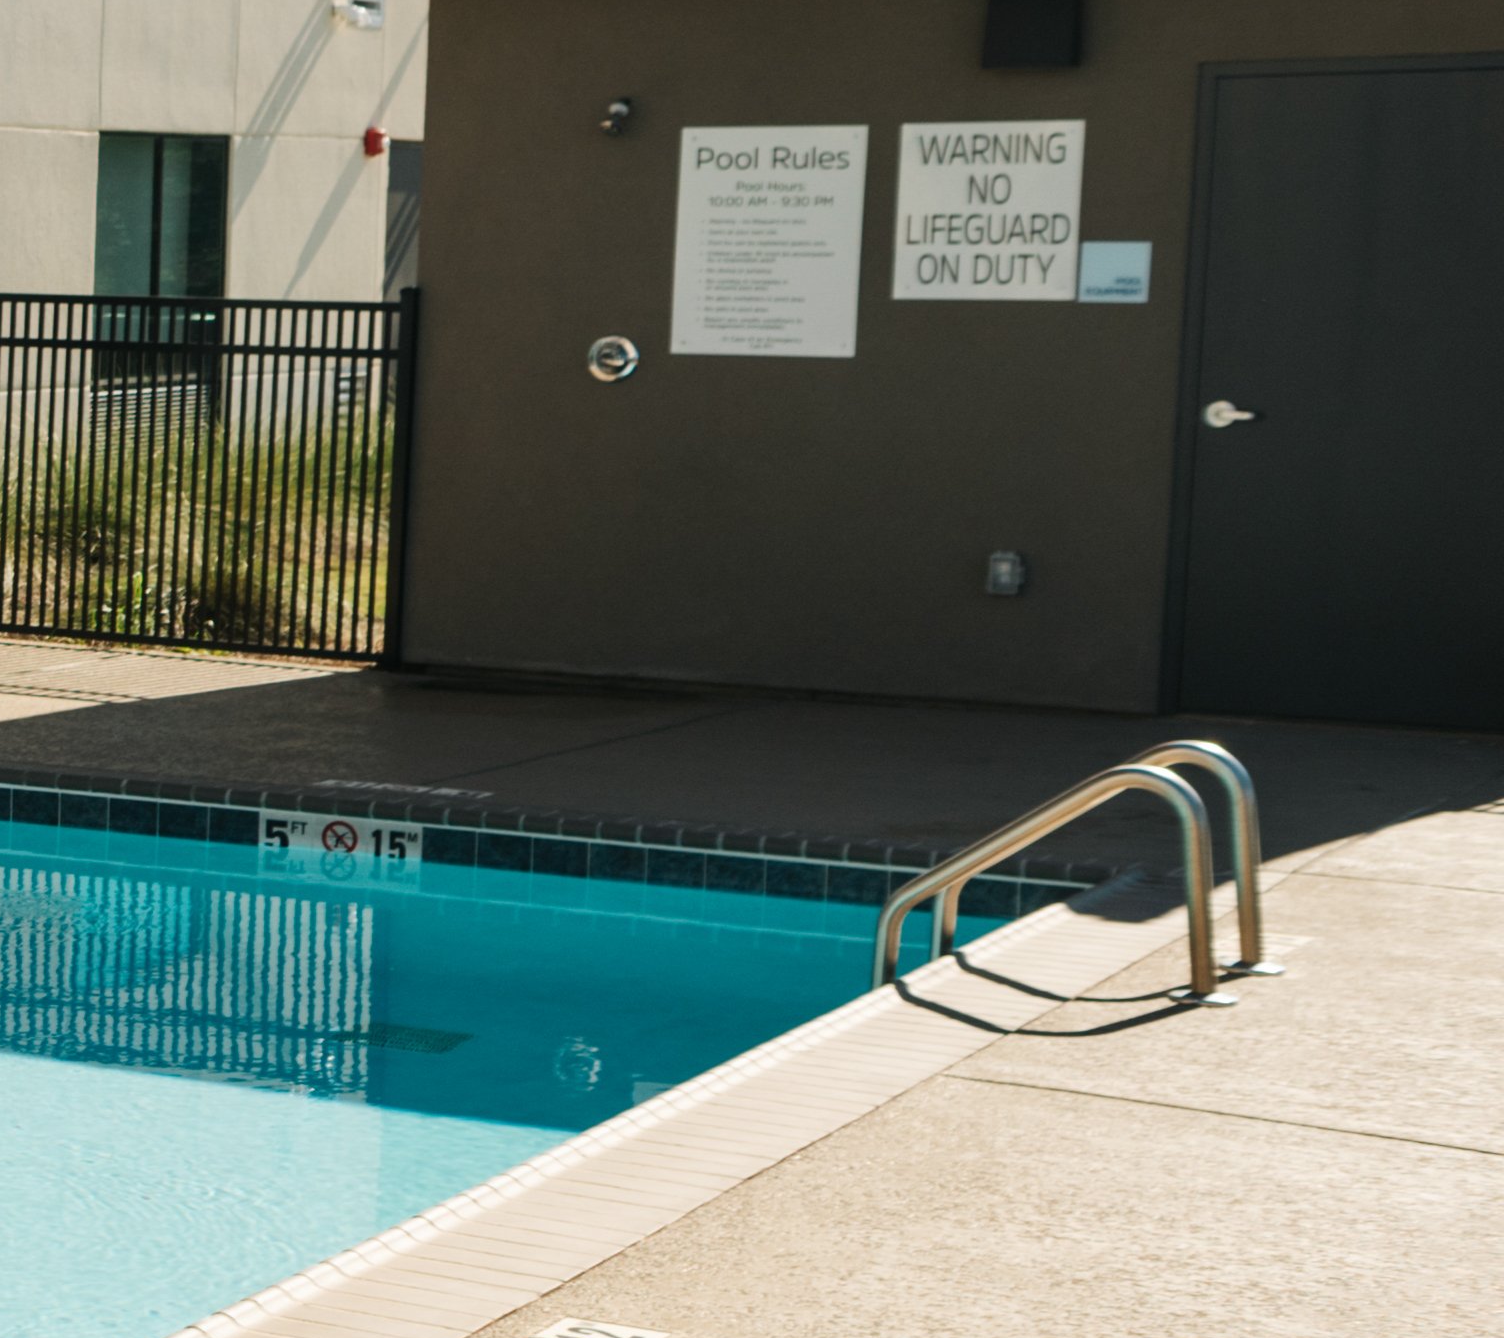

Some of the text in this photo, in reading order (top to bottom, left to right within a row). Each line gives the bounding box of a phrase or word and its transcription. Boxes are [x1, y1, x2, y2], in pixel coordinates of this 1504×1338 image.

[696, 146, 851, 171] Pool Rules
[918, 132, 1067, 166] WARNING
[967, 173, 1012, 205] NO
[905, 213, 1071, 245] LIFEGUARD
[916, 253, 1056, 285] ON DUTY
[265, 819, 309, 848] 5 FT
